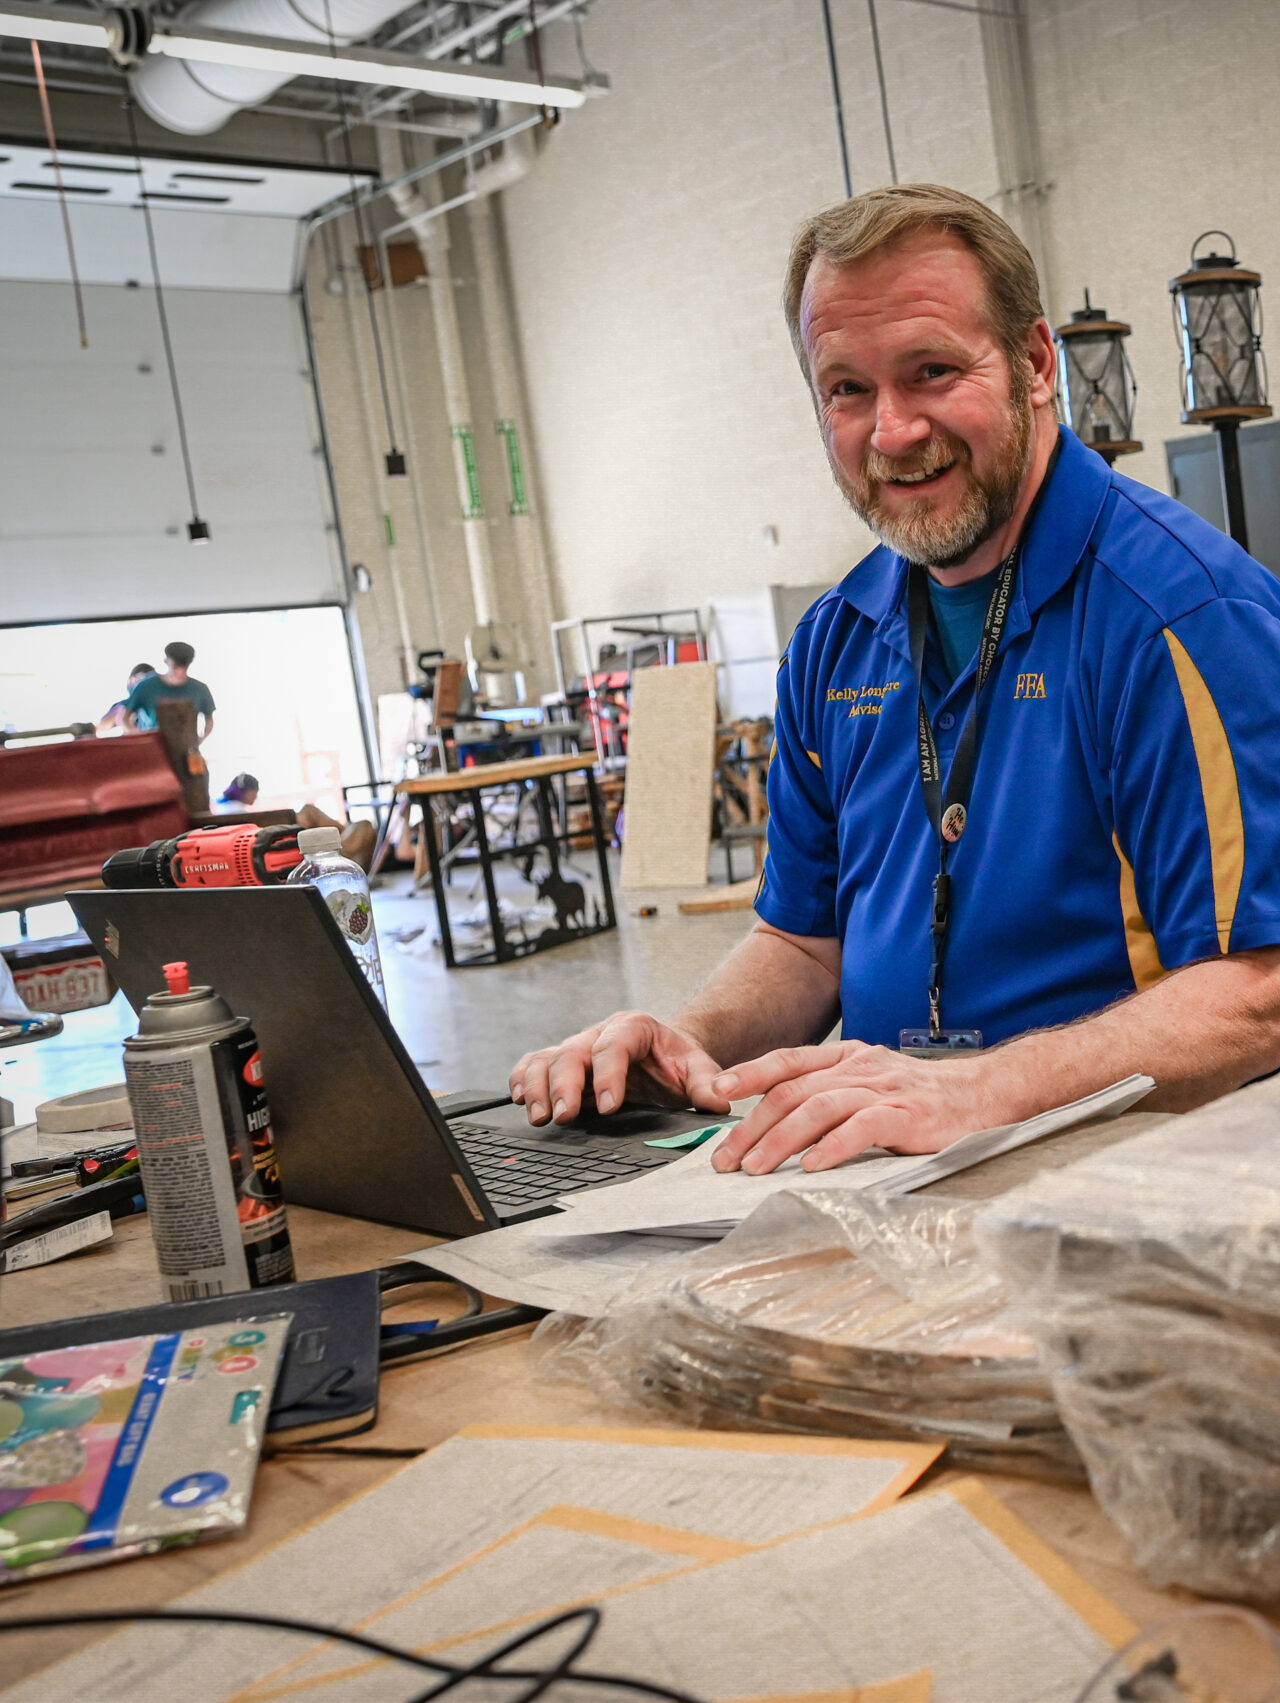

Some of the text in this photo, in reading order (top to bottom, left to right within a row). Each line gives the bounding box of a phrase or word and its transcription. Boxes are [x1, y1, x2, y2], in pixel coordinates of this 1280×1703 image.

[993, 568, 1012, 625] EDUCATOR
[990, 626, 1001, 642] BY
[1013, 672, 1047, 700] FFA
[826, 687, 859, 703] Kelly
[920, 742, 930, 758] AN
[920, 759, 932, 775] AM
[184, 861, 230, 875] CRAFTSMAN
